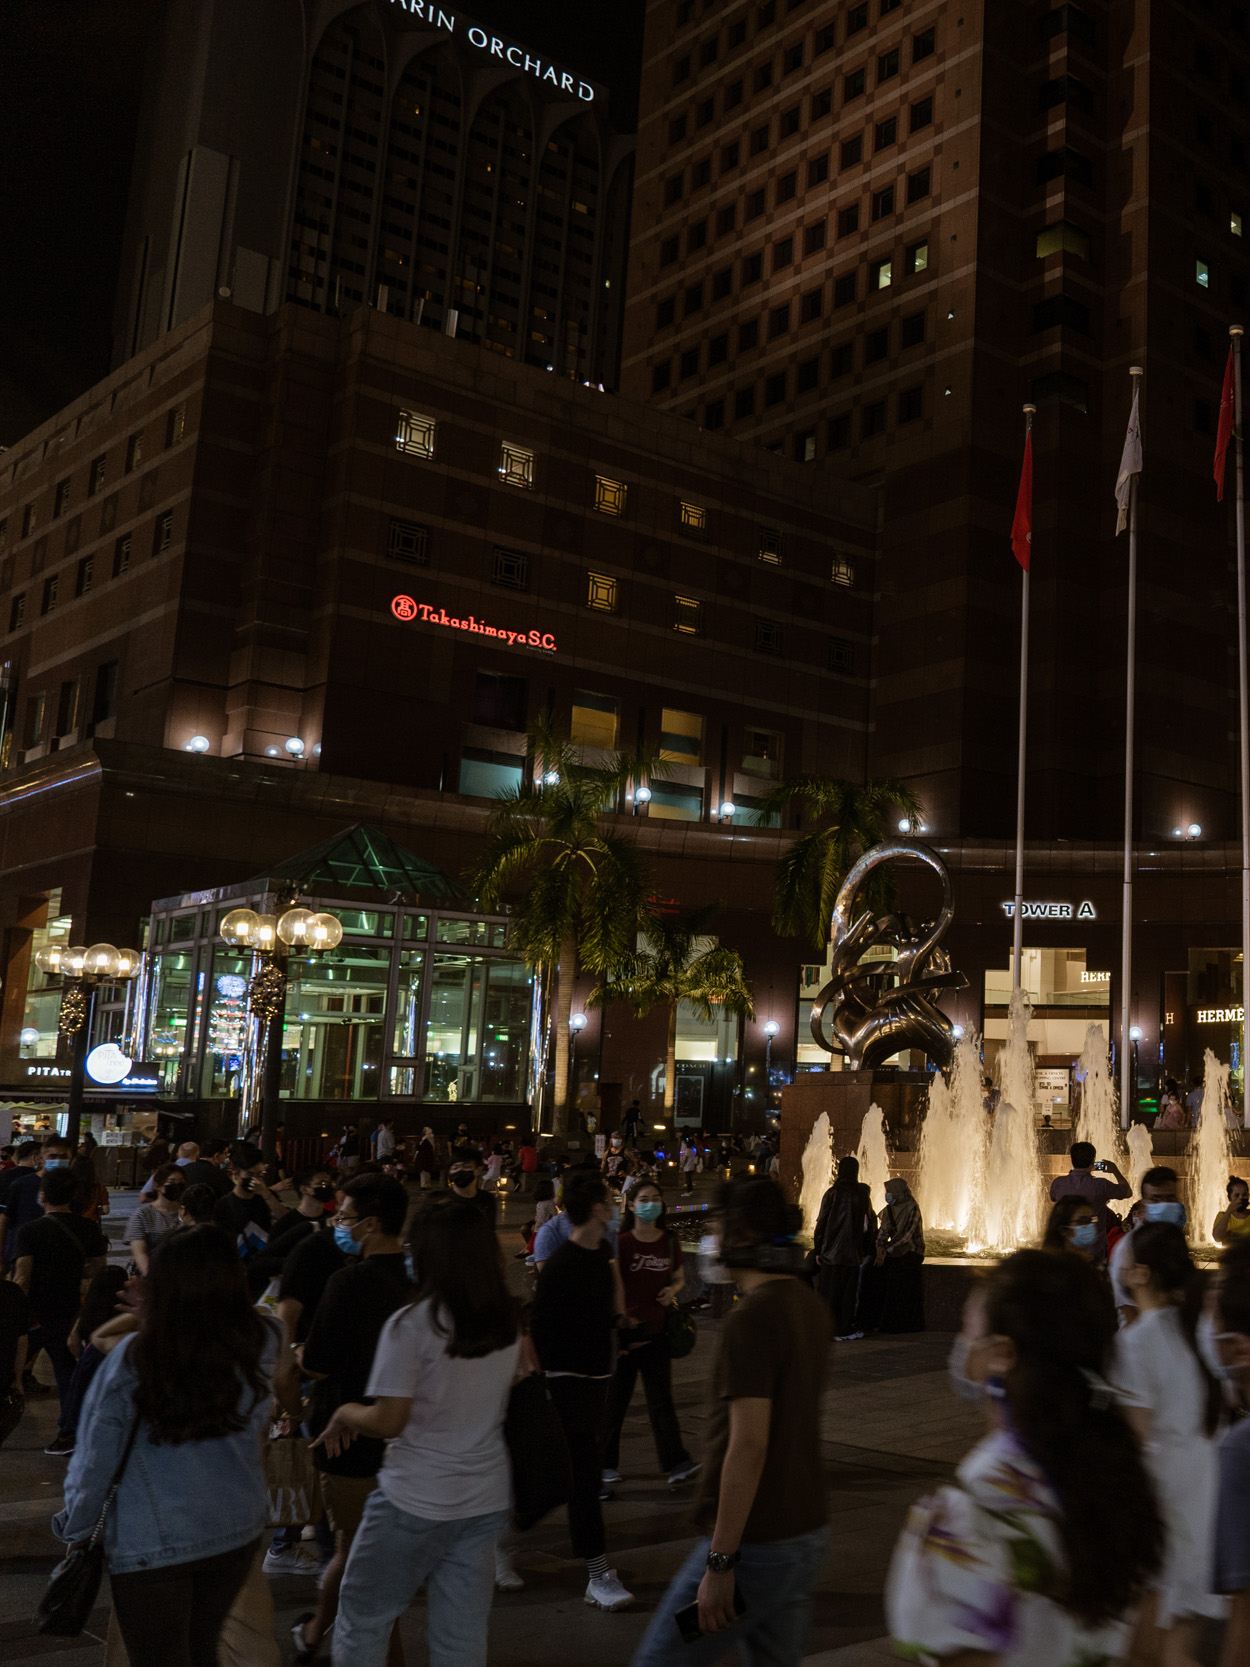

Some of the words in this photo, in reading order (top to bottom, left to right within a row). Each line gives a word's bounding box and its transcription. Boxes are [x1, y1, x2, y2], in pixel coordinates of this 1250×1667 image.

[468, 27, 594, 101] ORCHARD
[419, 603, 527, 645] Takashimaya
[1078, 901, 1097, 919] A
